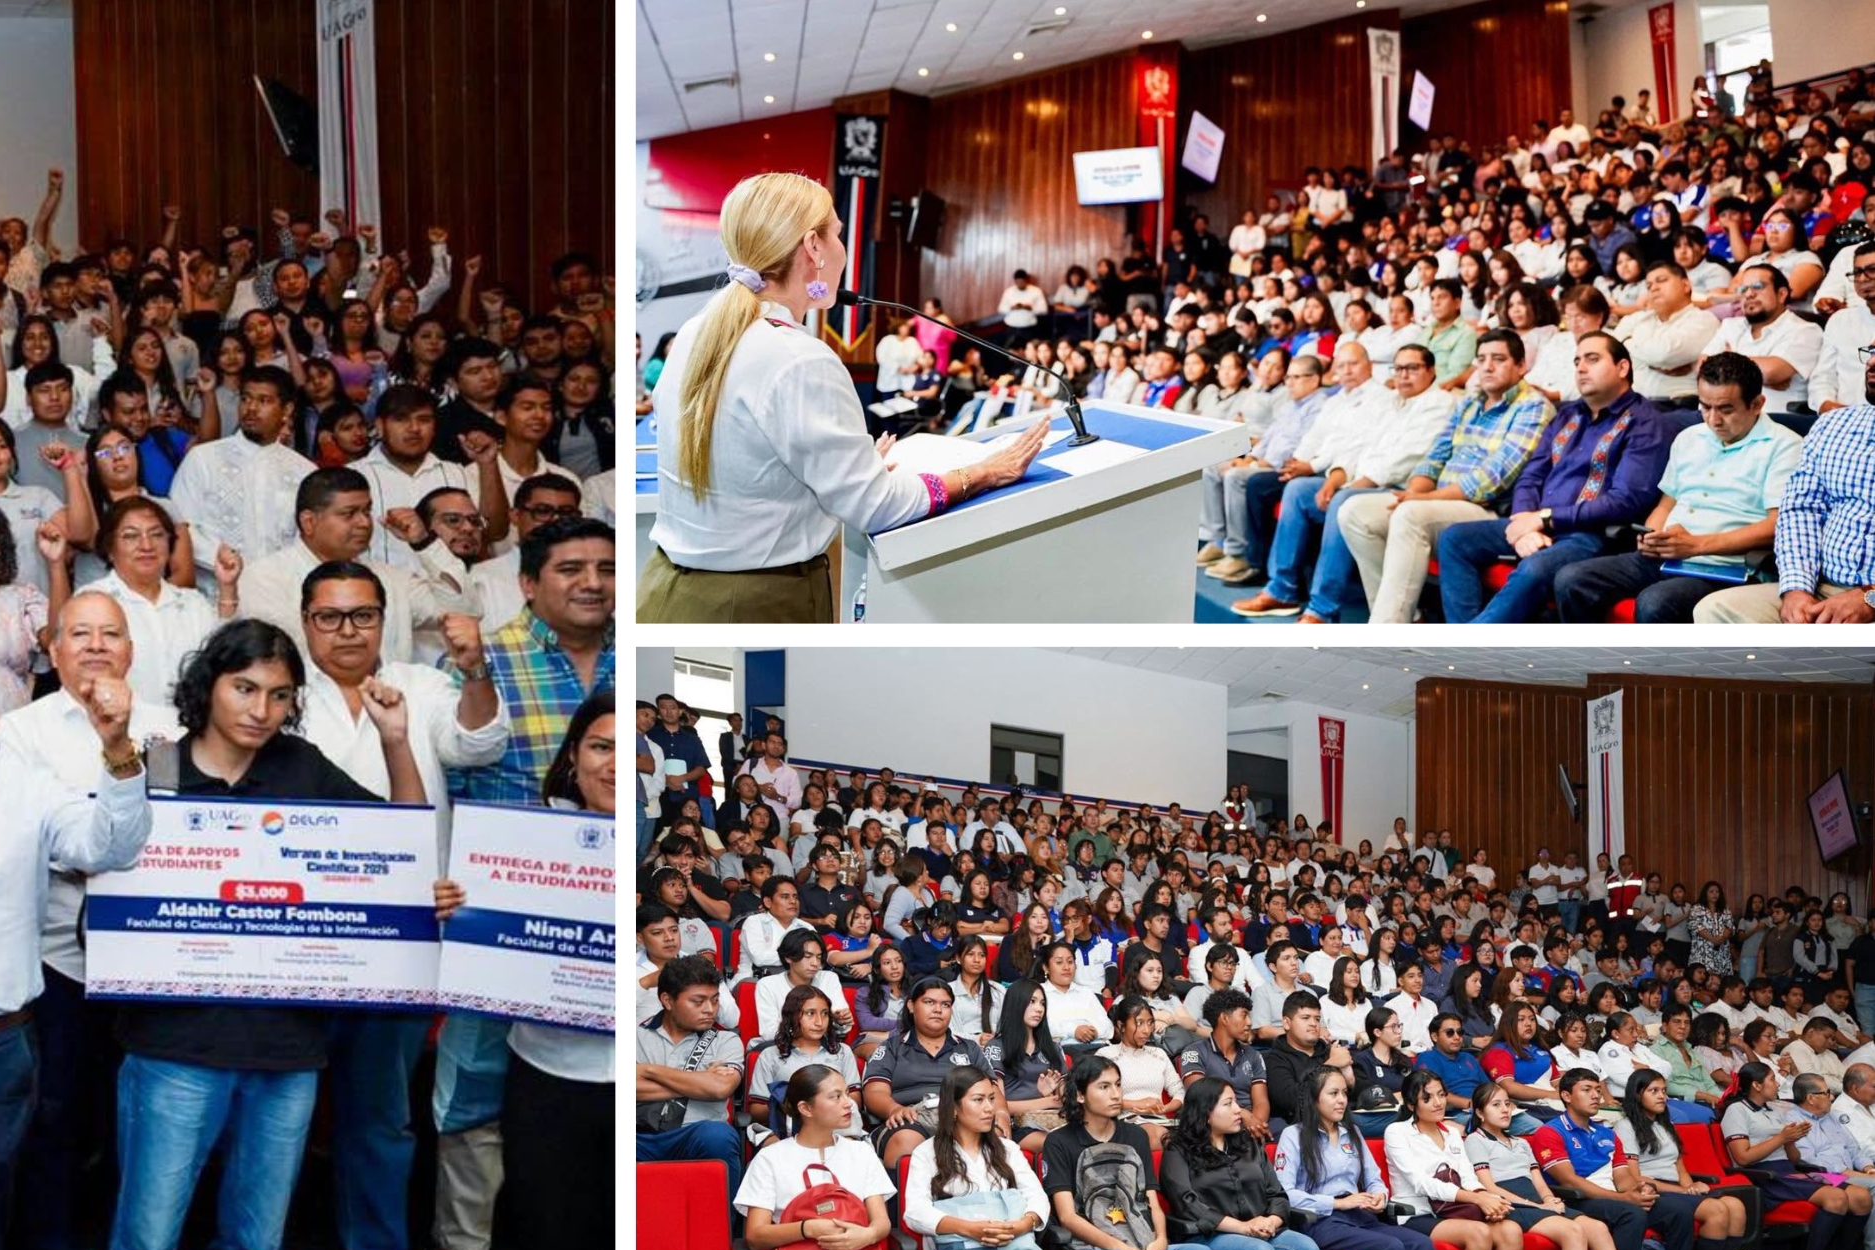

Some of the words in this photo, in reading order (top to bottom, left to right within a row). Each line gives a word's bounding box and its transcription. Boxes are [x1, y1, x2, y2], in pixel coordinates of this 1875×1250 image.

[469, 853, 544, 871] ENTREGA
[549, 862, 571, 874] DE
[235, 884, 288, 900] $3,000
[157, 902, 222, 918] Aldahir
[225, 904, 282, 920] Castor
[285, 906, 367, 923] Fombona
[126, 917, 172, 928] Facultad
[173, 919, 189, 929] de
[189, 919, 234, 930] Ciencias
[235, 923, 242, 932] y
[306, 924, 321, 933] de
[323, 924, 333, 934] la
[524, 919, 583, 941] Ninel
